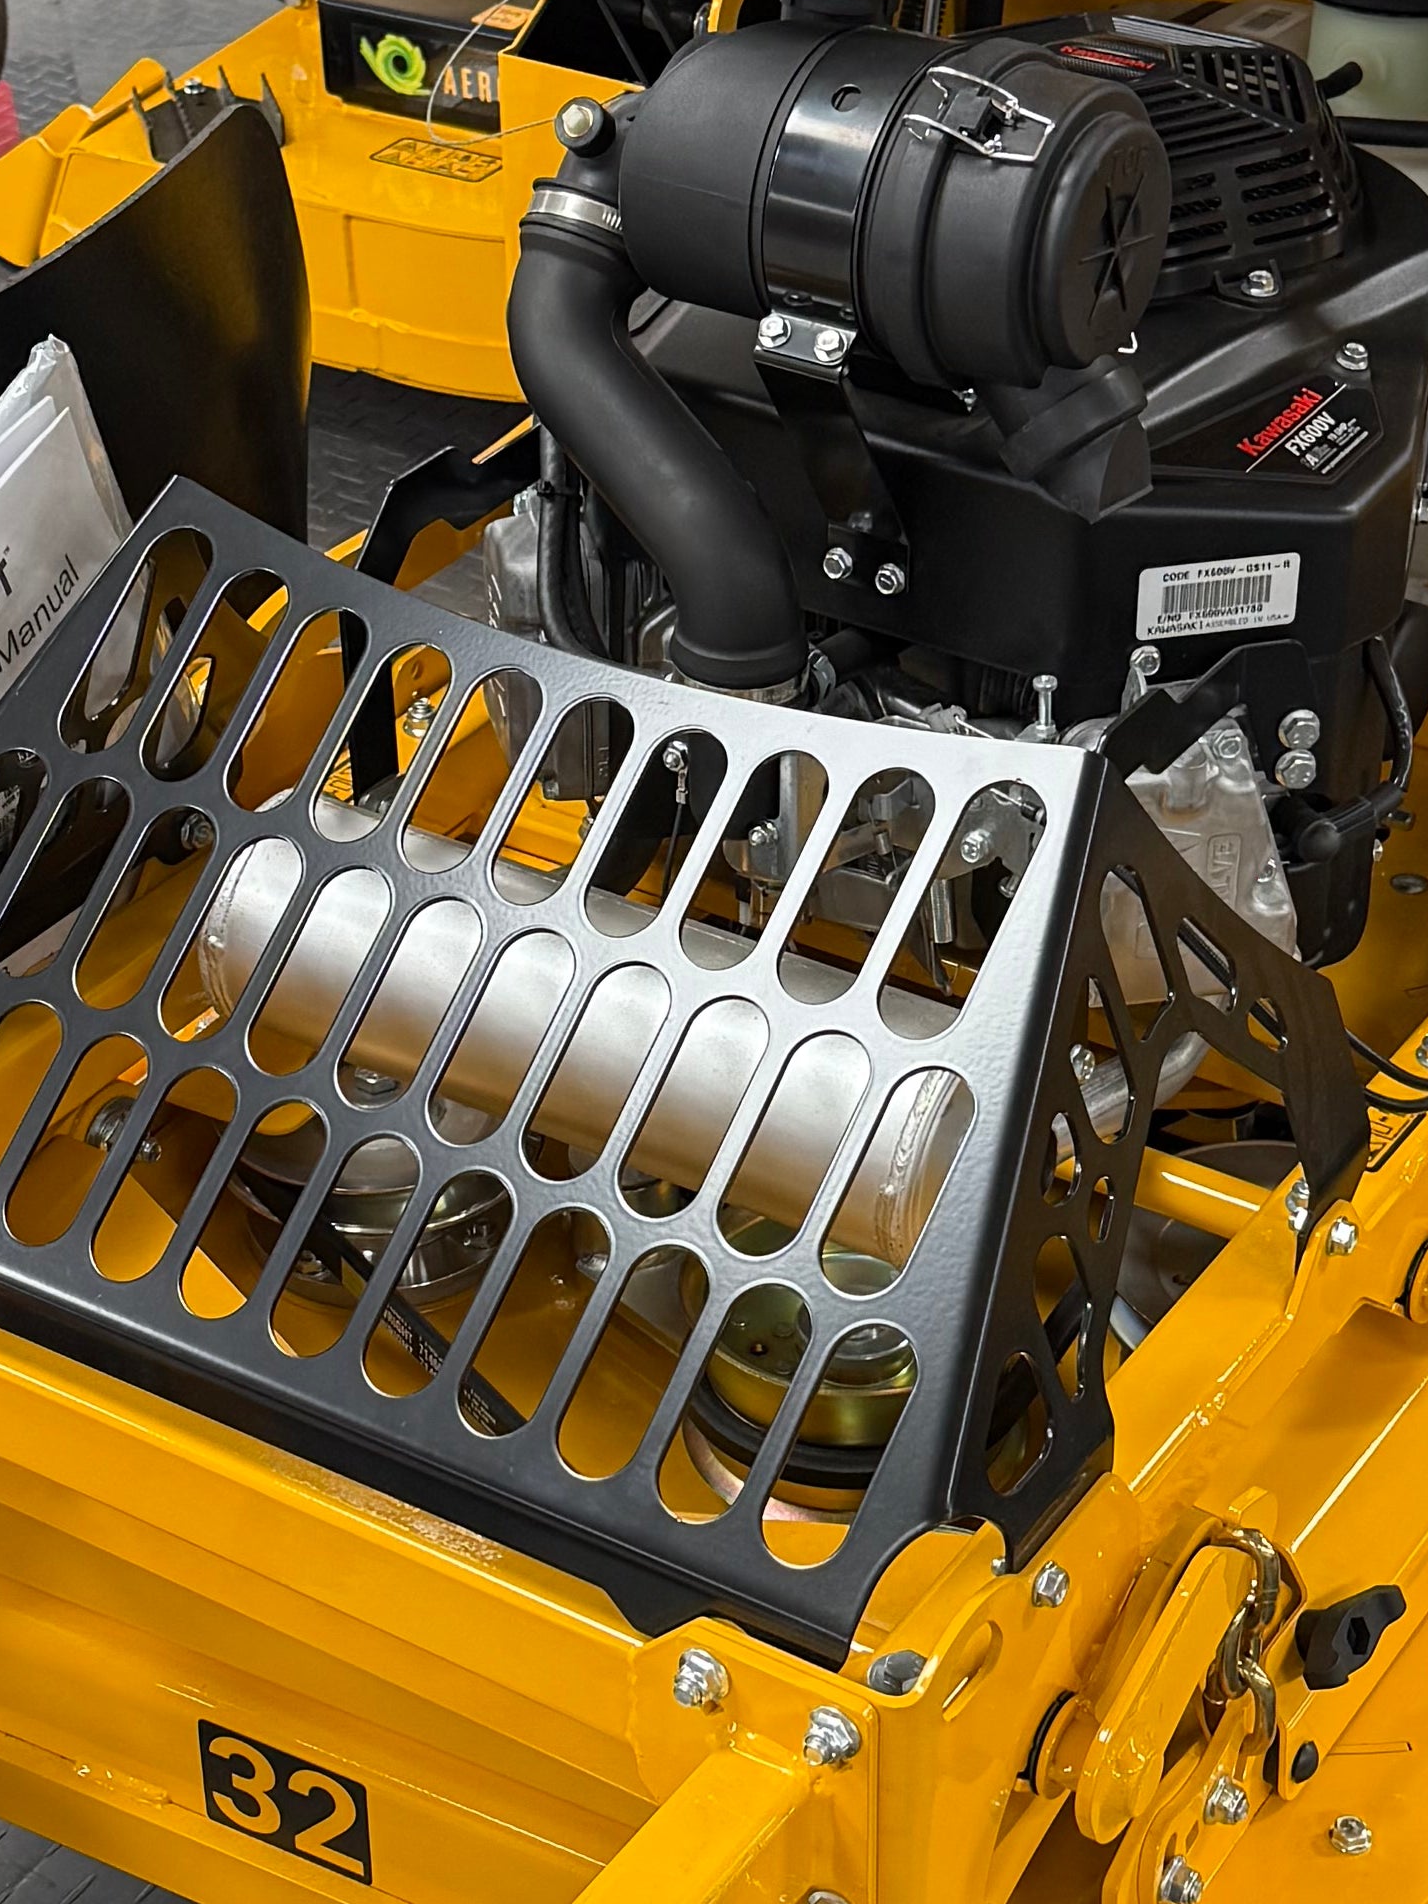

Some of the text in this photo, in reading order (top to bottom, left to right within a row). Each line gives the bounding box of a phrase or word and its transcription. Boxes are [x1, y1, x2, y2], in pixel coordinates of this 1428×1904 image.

[1236, 387, 1323, 457] Kawasaki
[1284, 411, 1336, 457] FX600V
[1162, 570, 1191, 583] CODE
[209, 1736, 365, 1877] 32
